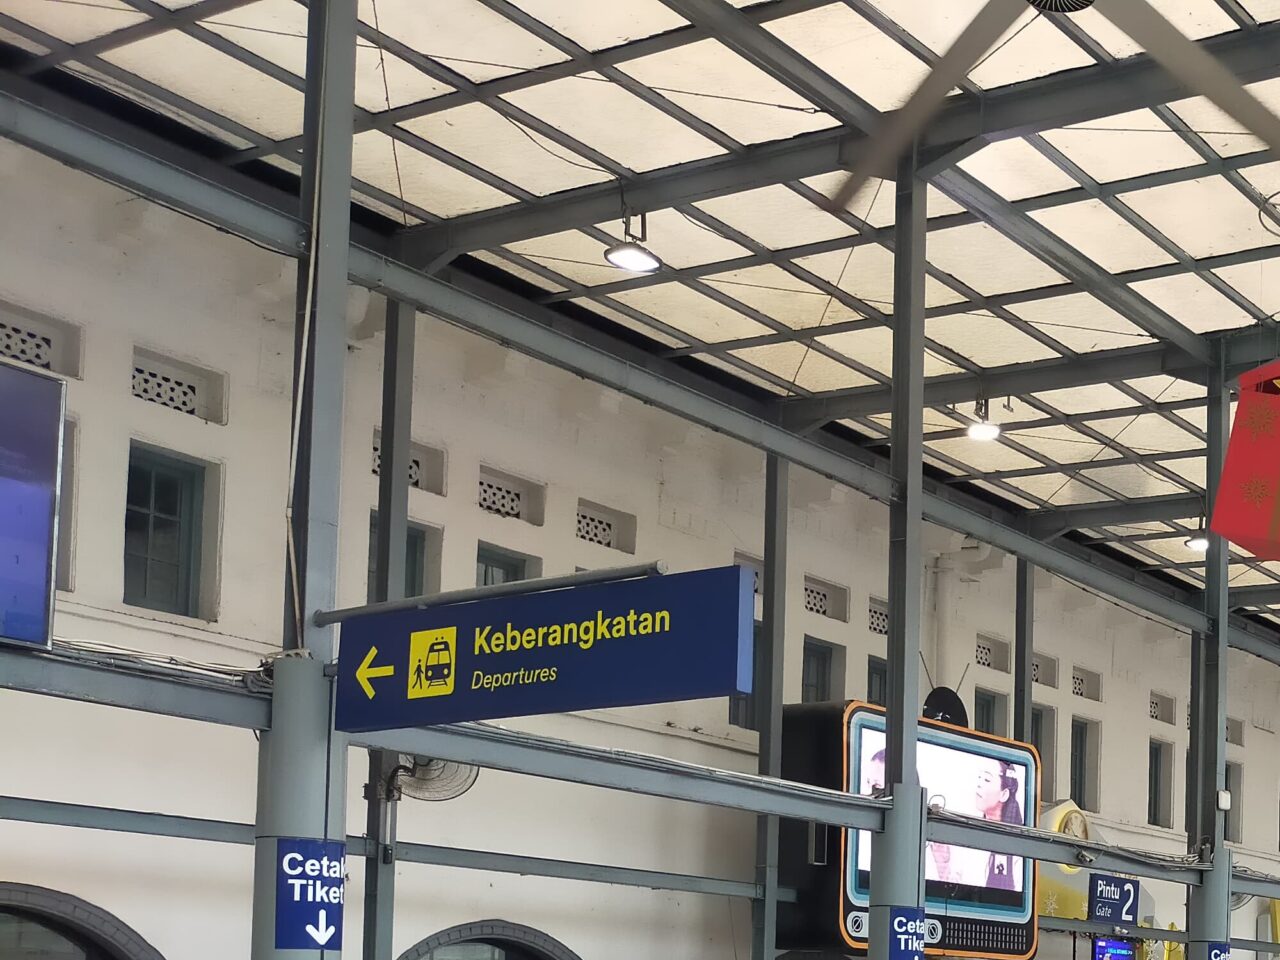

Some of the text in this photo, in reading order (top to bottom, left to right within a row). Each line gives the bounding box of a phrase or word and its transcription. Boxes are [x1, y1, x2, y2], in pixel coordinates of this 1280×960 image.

[473, 608, 671, 656] Keberangkatan
[472, 665, 558, 692] Departures
[1097, 880, 1120, 900] Pintu
[1122, 883, 1135, 922] 2
[1096, 903, 1112, 917] Gate
